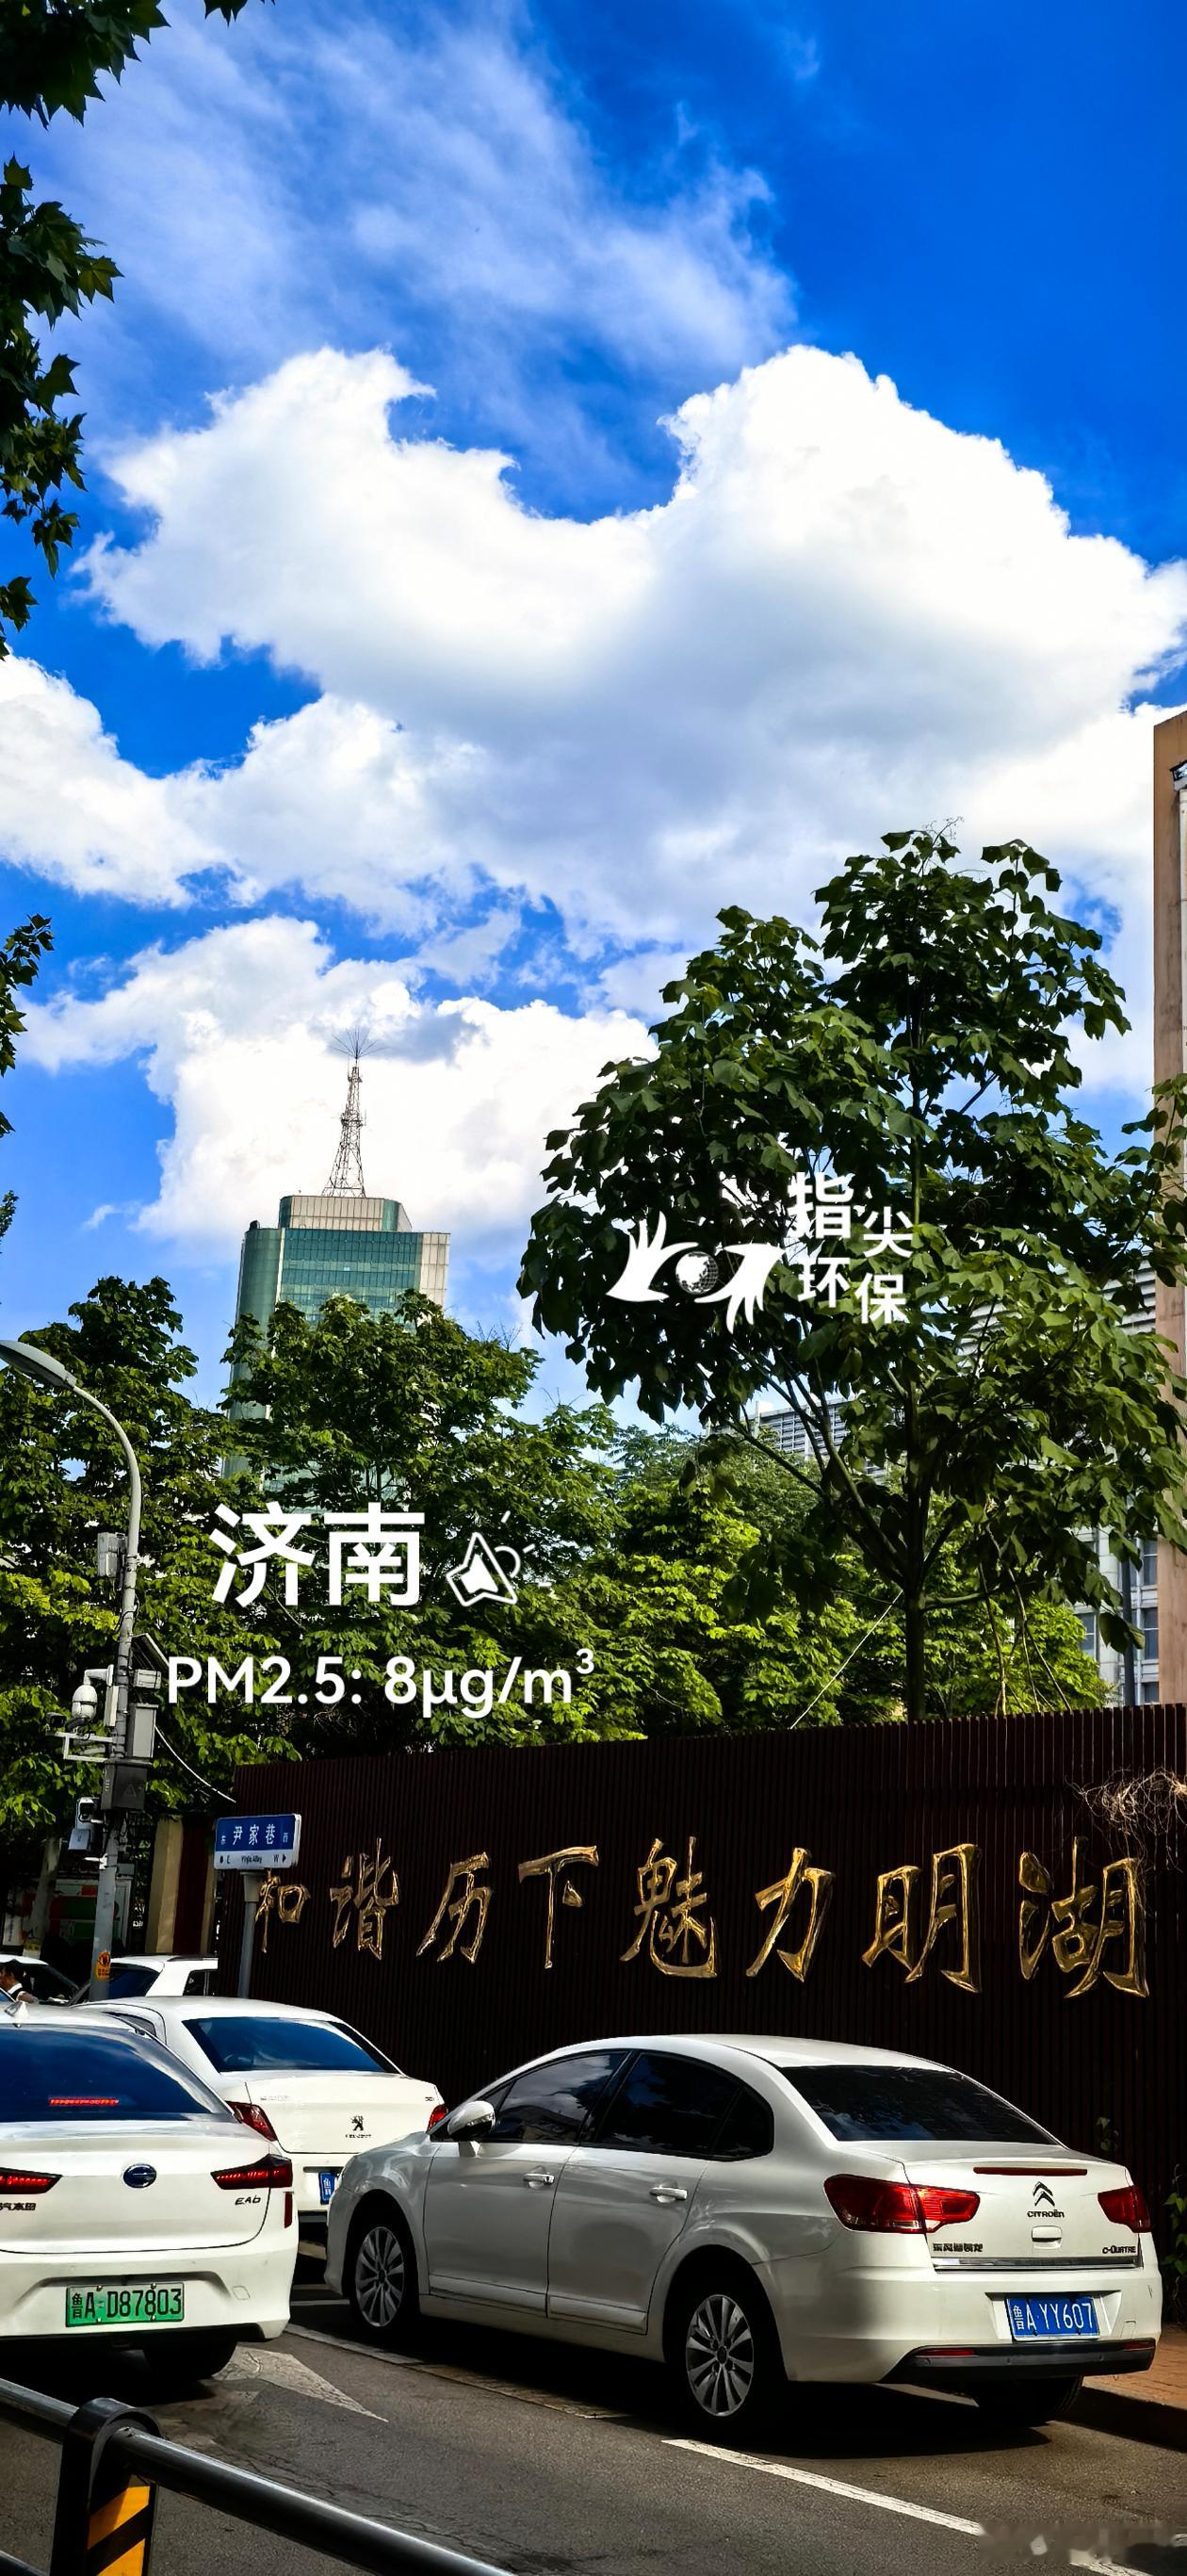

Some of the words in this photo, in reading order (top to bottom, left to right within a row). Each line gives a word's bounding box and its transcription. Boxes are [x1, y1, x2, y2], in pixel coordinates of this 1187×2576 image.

[232, 1823, 276, 1846] 尹家巷
[254, 1836, 1150, 1998] 和谐历下魅力明湖
